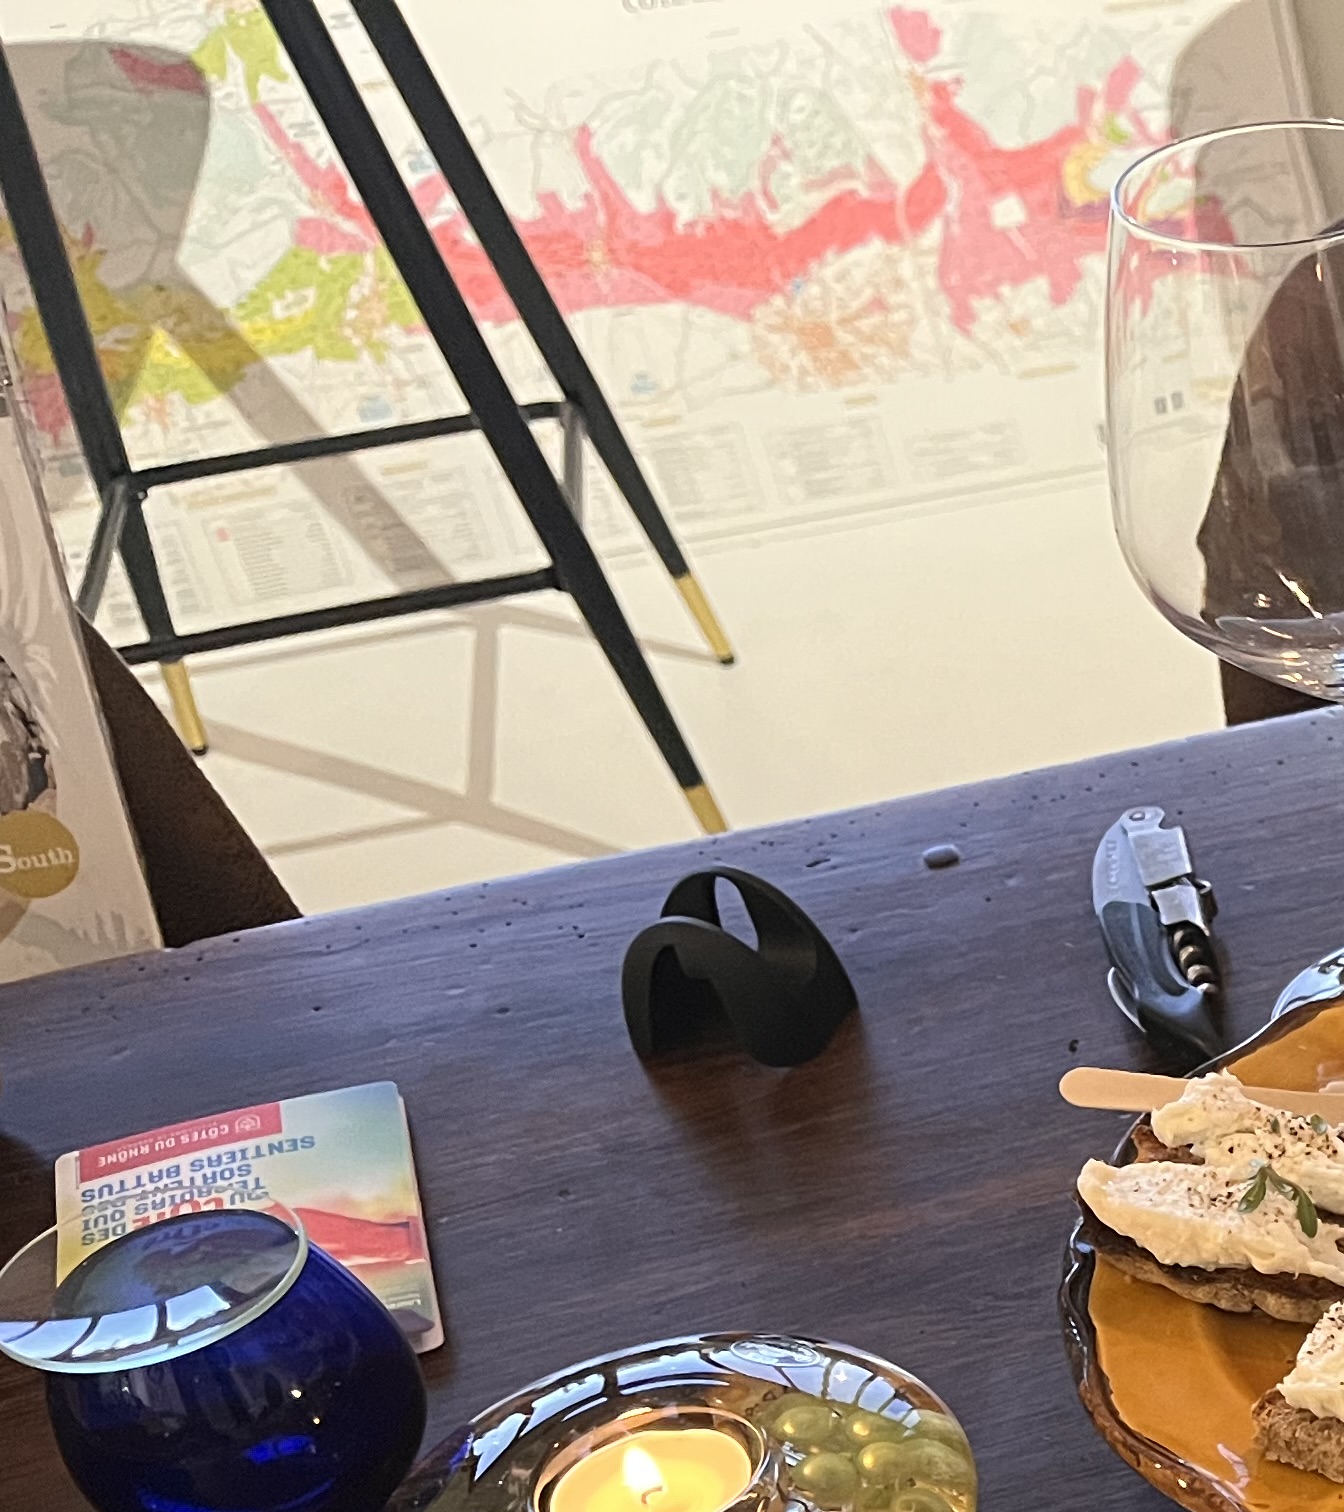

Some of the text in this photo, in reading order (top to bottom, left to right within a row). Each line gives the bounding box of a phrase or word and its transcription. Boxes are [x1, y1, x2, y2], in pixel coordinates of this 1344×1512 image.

[0, 844, 76, 874] South
[154, 1135, 177, 1151] DU
[181, 1123, 229, 1146] CÔTES
[98, 1141, 149, 1167] RHÔNE
[190, 1135, 316, 1170] SENTIERS
[81, 1164, 181, 1204] BATTUS
[82, 1208, 126, 1233] QUI
[82, 1222, 127, 1246] DES
